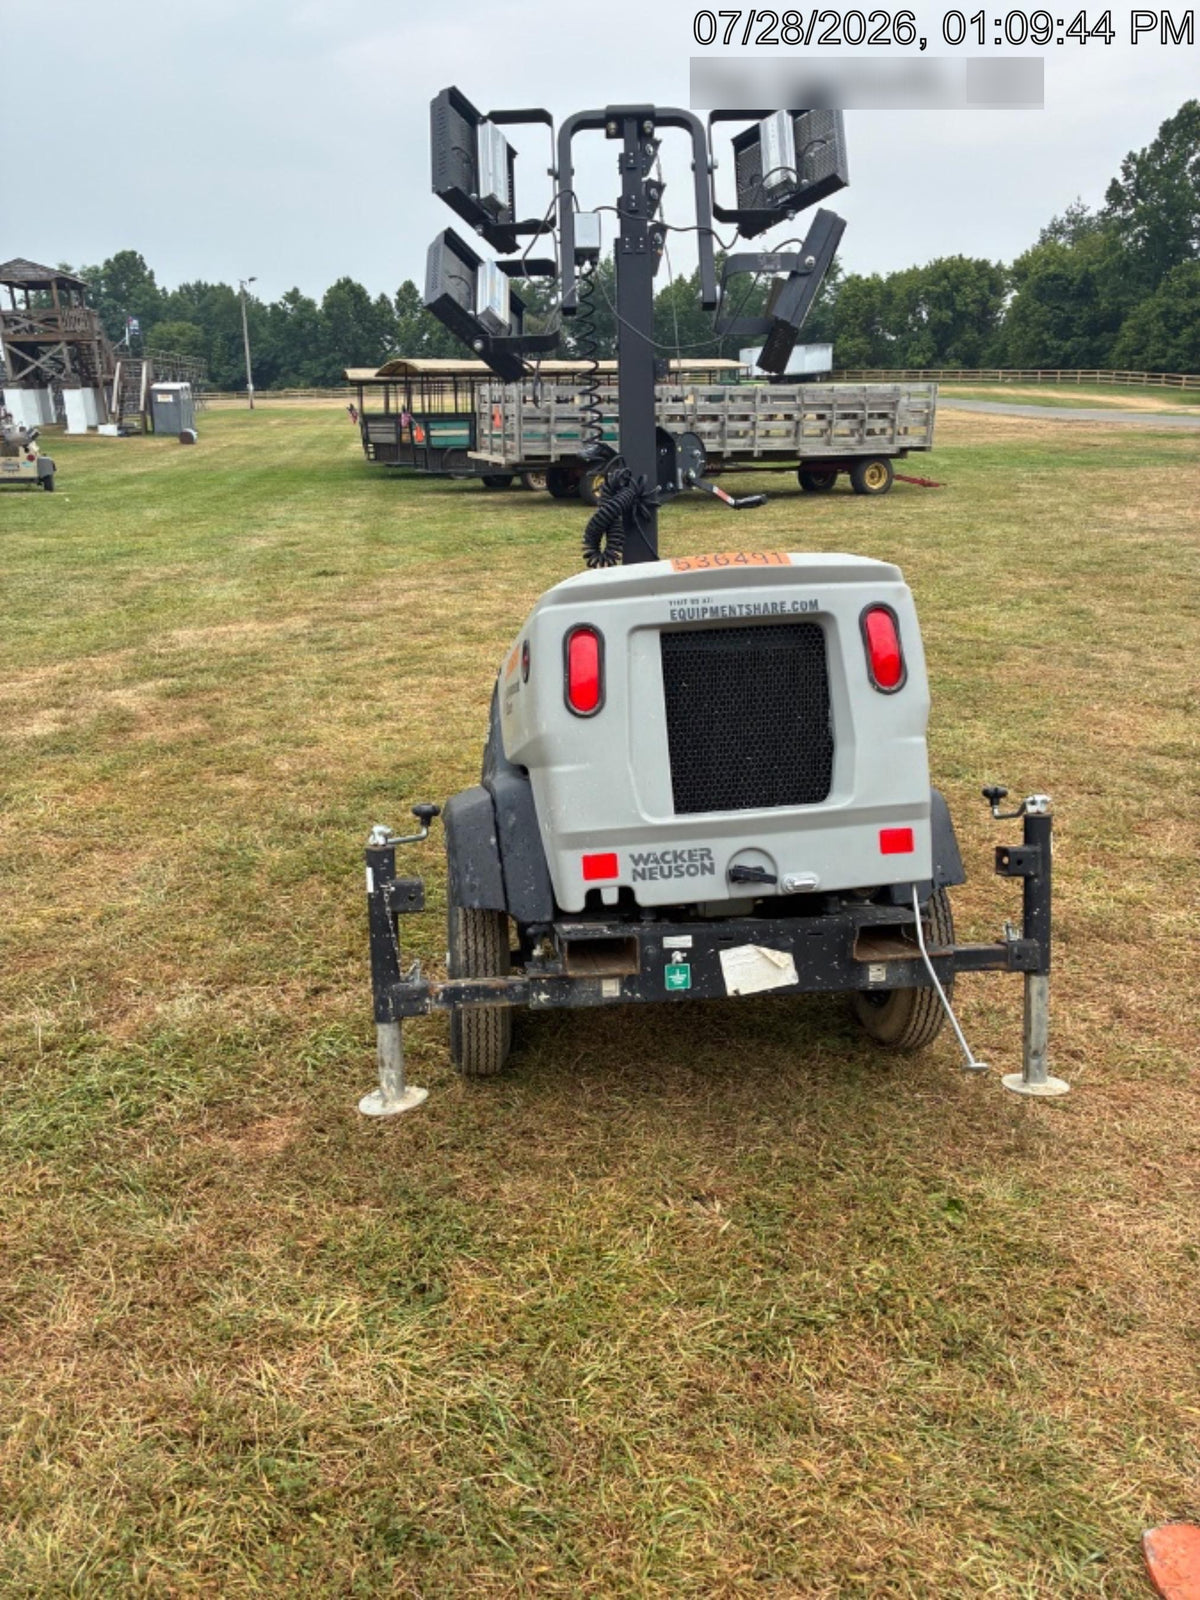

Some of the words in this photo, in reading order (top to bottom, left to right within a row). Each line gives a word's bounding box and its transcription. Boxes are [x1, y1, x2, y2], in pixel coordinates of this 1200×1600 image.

[674, 552, 785, 571] 536491
[670, 599, 819, 621] EQUIPMENTSHARE.COM
[629, 848, 713, 866] WACKER
[632, 862, 715, 882] NEUSON
